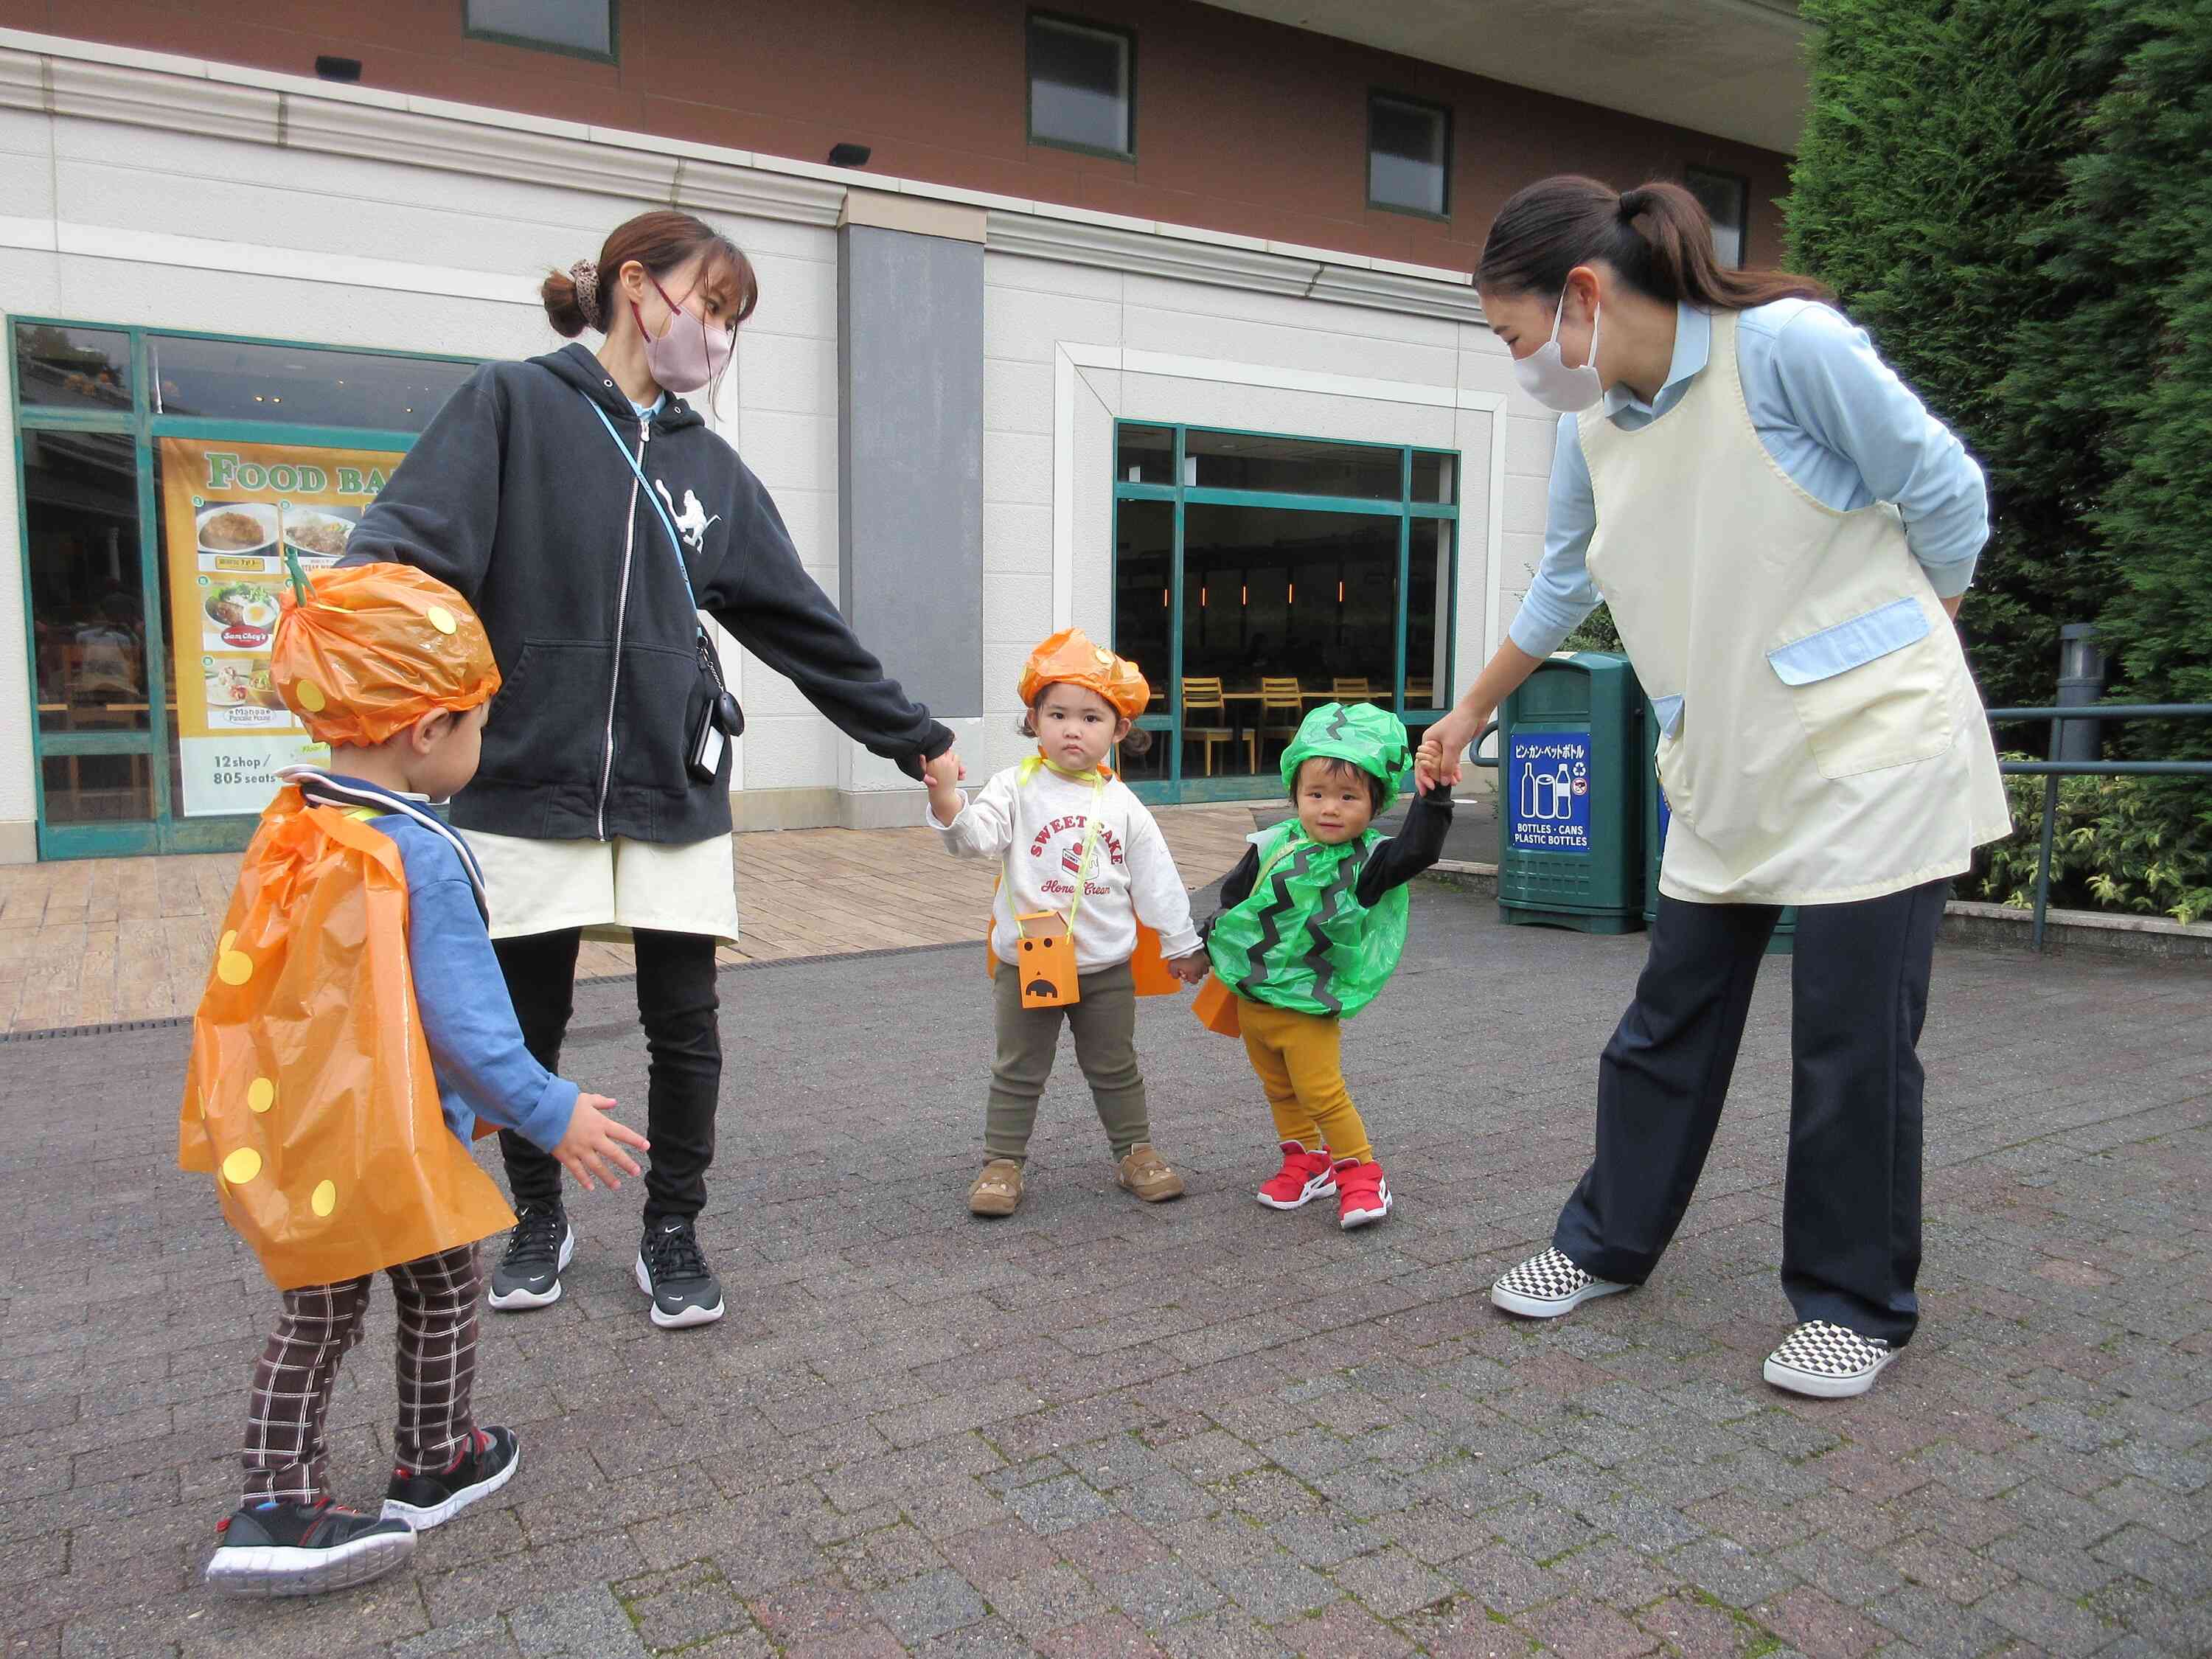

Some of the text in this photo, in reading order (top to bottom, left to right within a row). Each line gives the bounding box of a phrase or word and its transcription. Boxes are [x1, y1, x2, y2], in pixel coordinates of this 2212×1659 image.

[204, 452, 394, 494] FOOD BA
[213, 772, 243, 784] 805
[1517, 823, 1551, 834] BOTTLES
[1559, 825, 1584, 835] CANS
[1030, 815, 1087, 857] SWEET
[1514, 833, 1587, 846] PLASTIC BOTTLES
[1041, 880, 1075, 894] Hone
